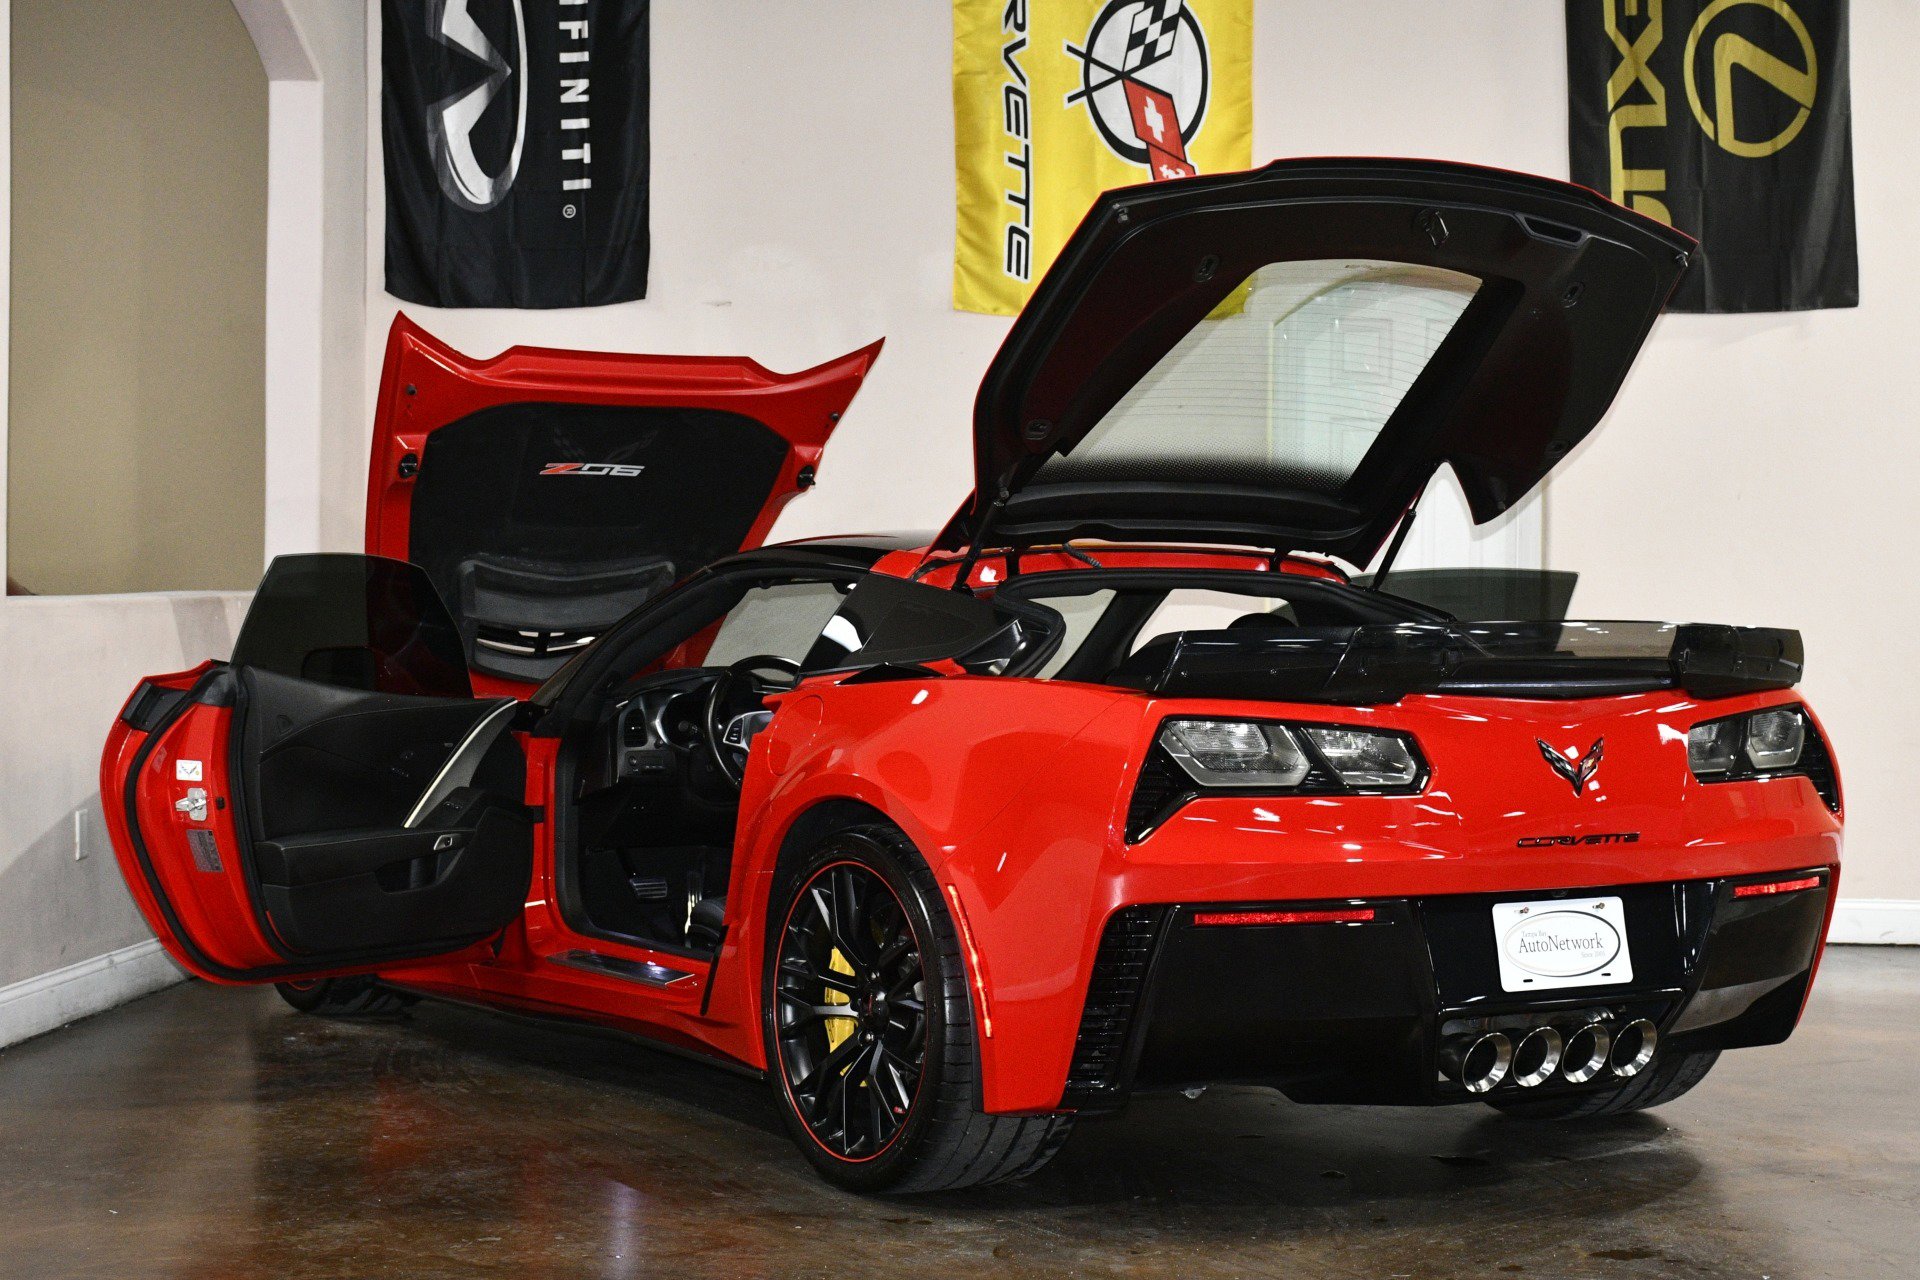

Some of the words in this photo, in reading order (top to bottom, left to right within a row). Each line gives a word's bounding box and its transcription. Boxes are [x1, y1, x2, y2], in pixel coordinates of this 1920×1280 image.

[559, 0, 591, 191] FINITI
[539, 462, 646, 477] Z06
[1517, 832, 1640, 848] CORVETTE
[1519, 932, 1605, 953] AutoNetwork
